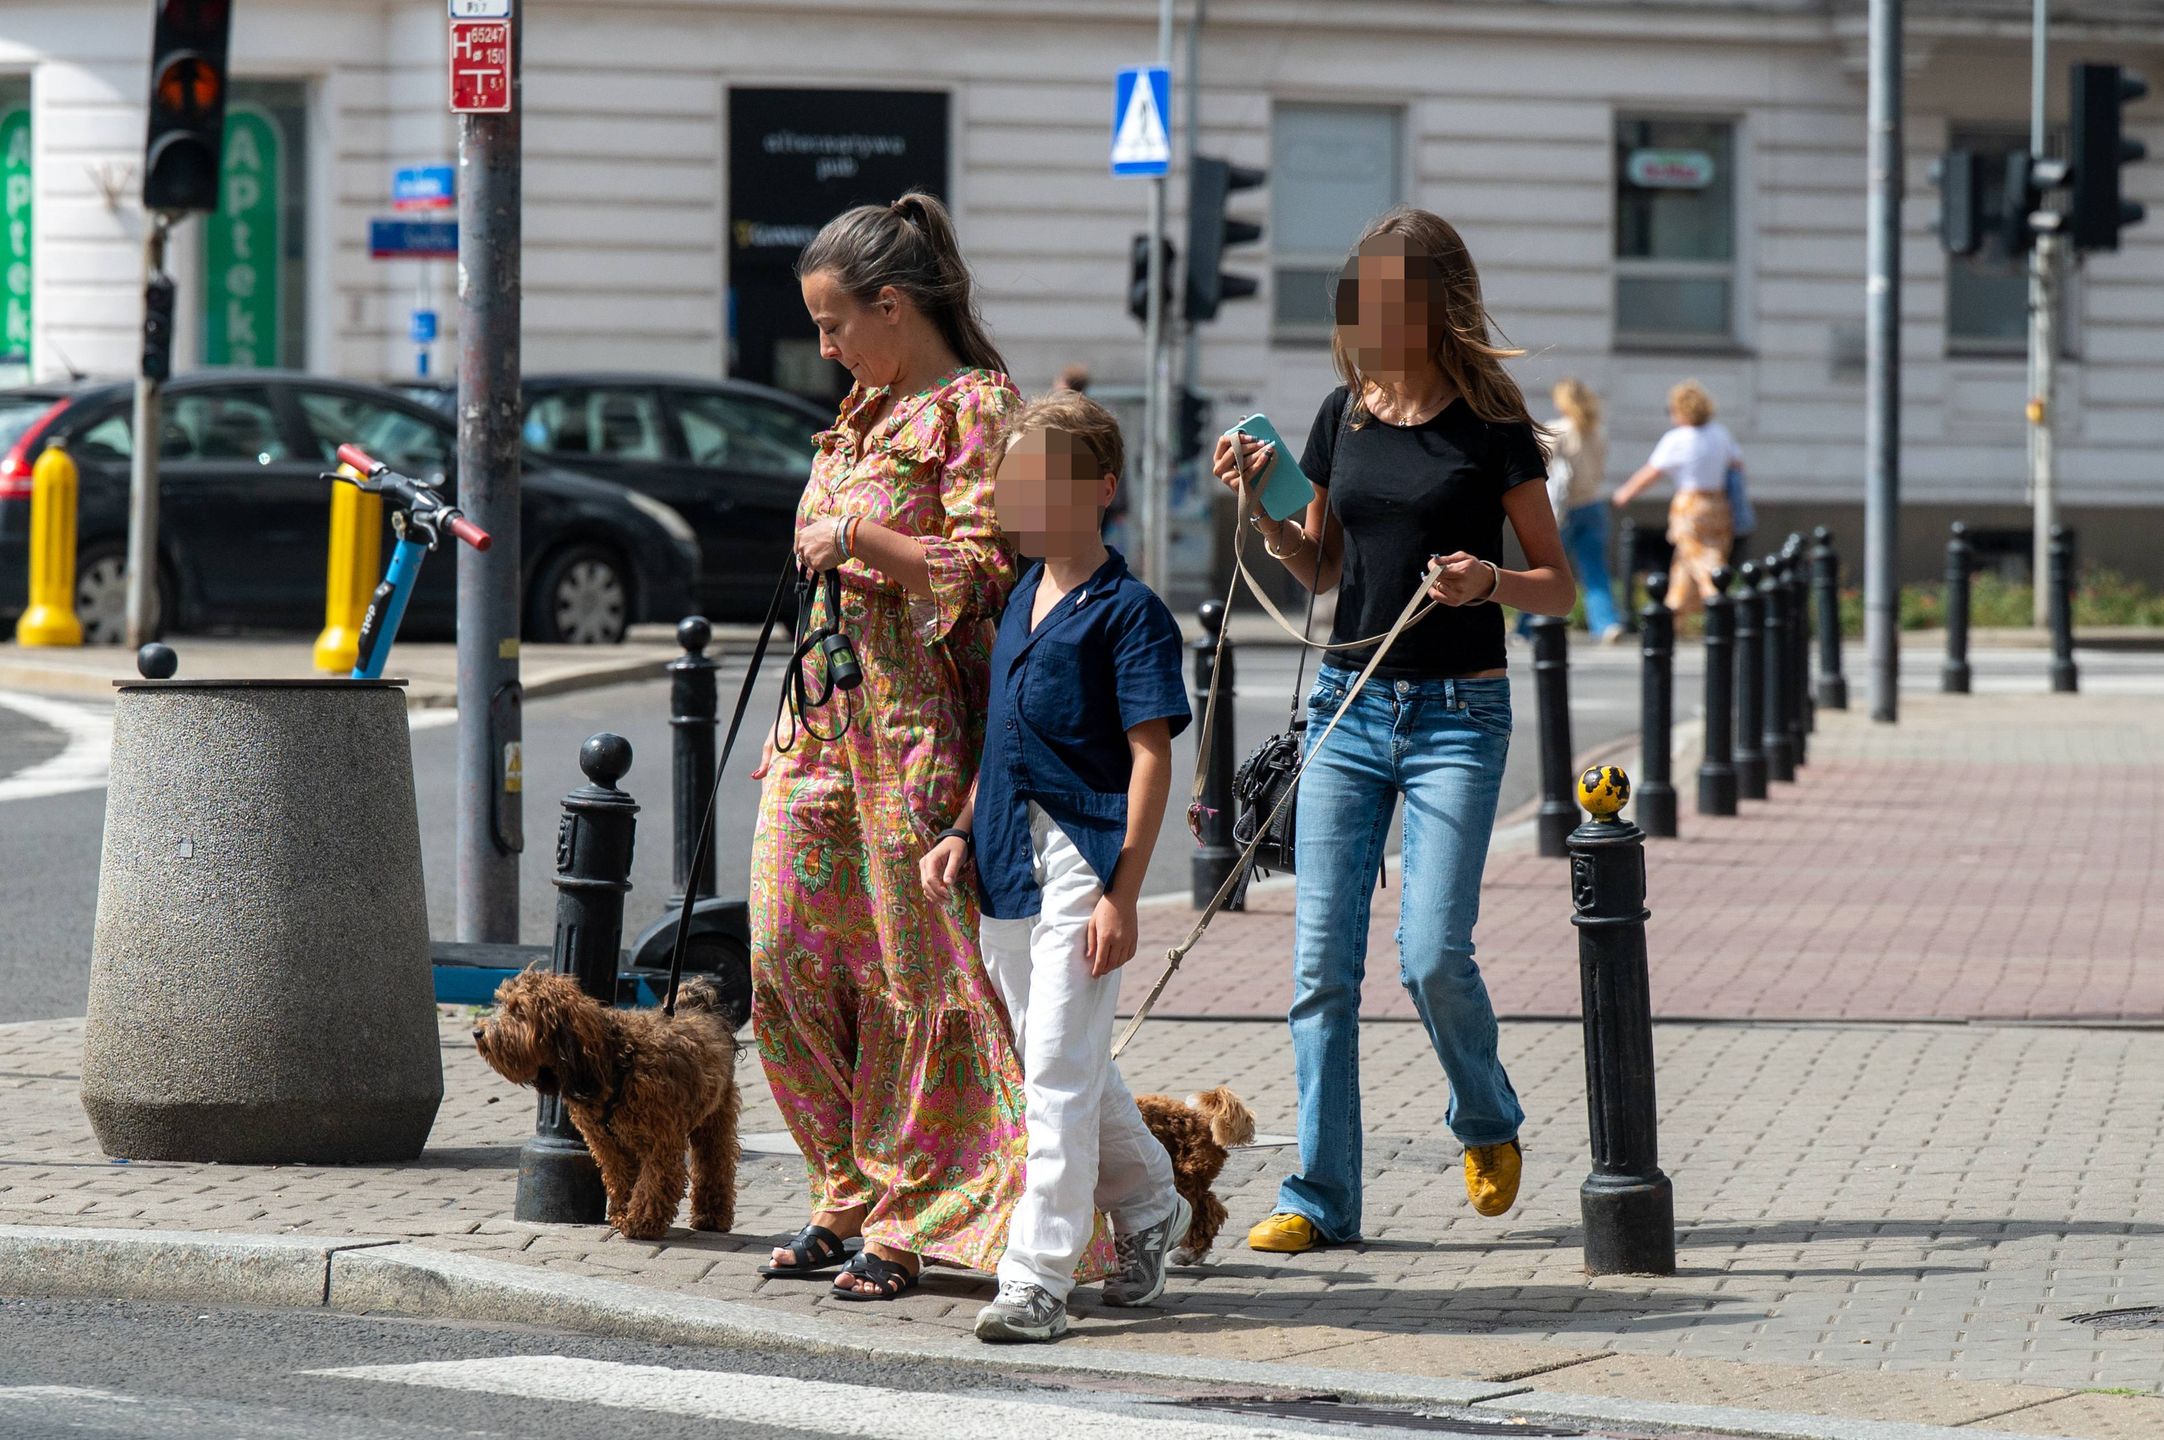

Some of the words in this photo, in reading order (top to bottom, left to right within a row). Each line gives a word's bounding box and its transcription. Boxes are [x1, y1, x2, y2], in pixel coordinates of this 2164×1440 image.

[471, 27, 505, 43] 65247
[453, 32, 471, 58] H
[486, 48, 505, 64] 150
[361, 604, 376, 634] dott
[1144, 1232, 1163, 1250] N
[1037, 1292, 1055, 1313] N
